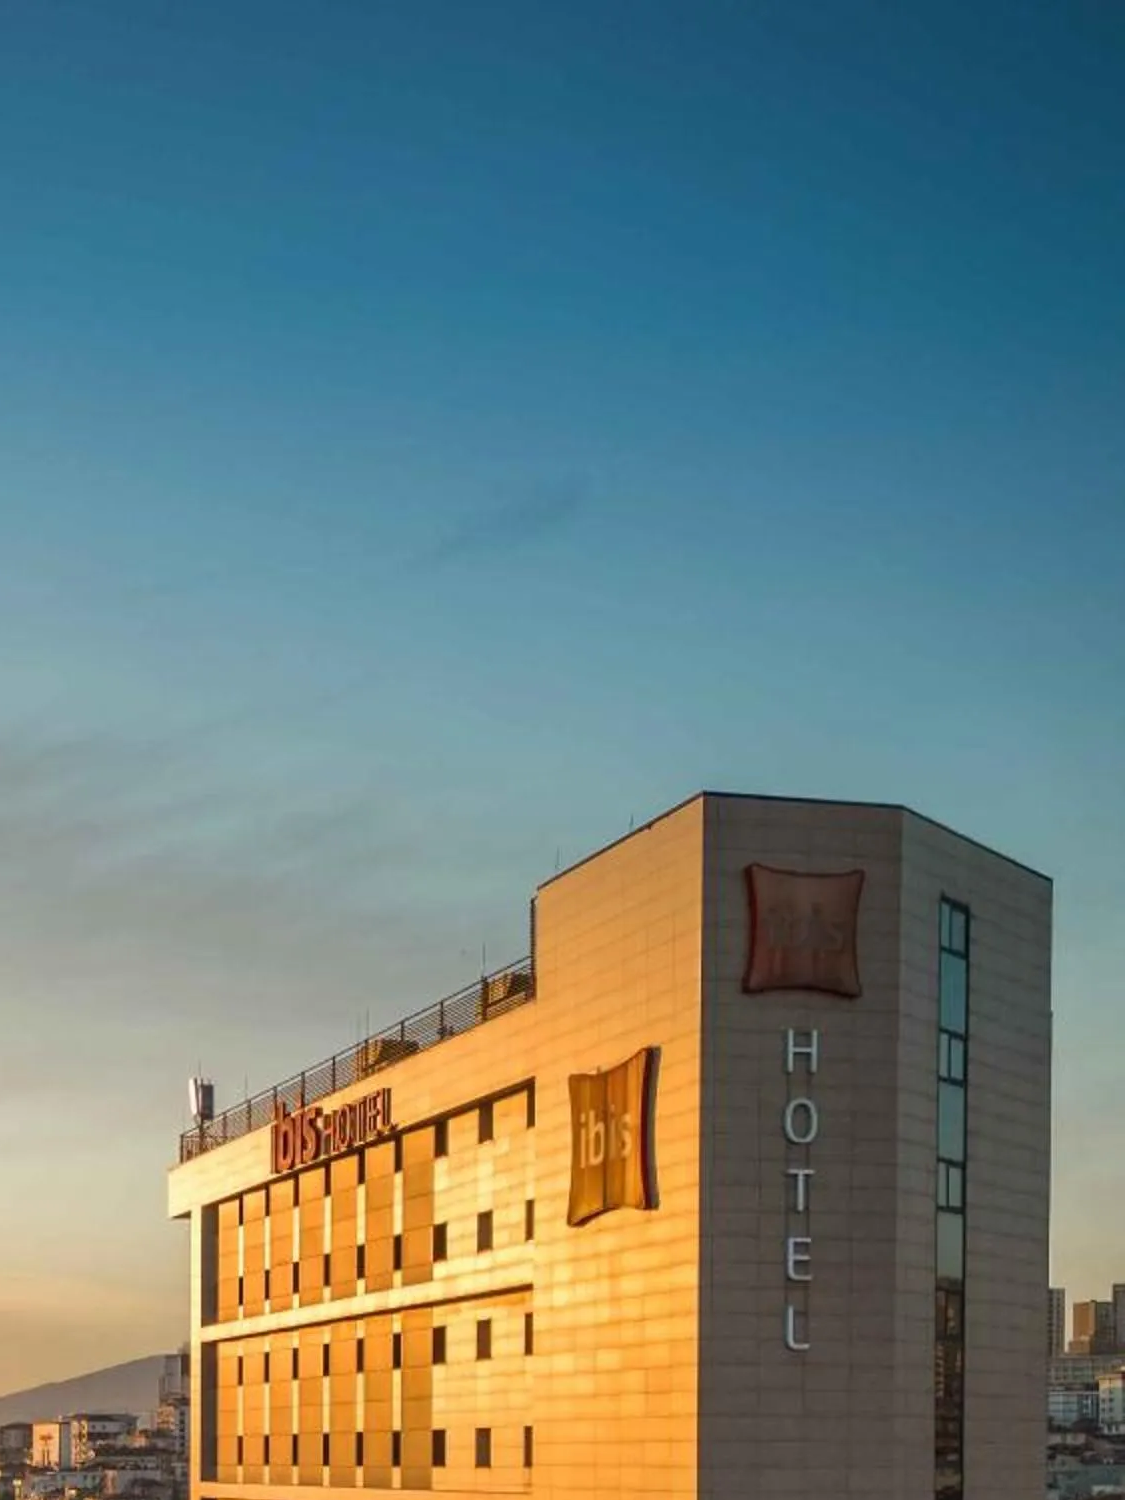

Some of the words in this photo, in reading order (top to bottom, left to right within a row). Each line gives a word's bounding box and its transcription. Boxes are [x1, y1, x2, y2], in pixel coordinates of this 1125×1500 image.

[270, 1096, 322, 1173] ibis
[322, 1088, 395, 1155] HOTEL
[579, 1104, 632, 1169] ibis
[784, 1028, 819, 1350] HOTEL
